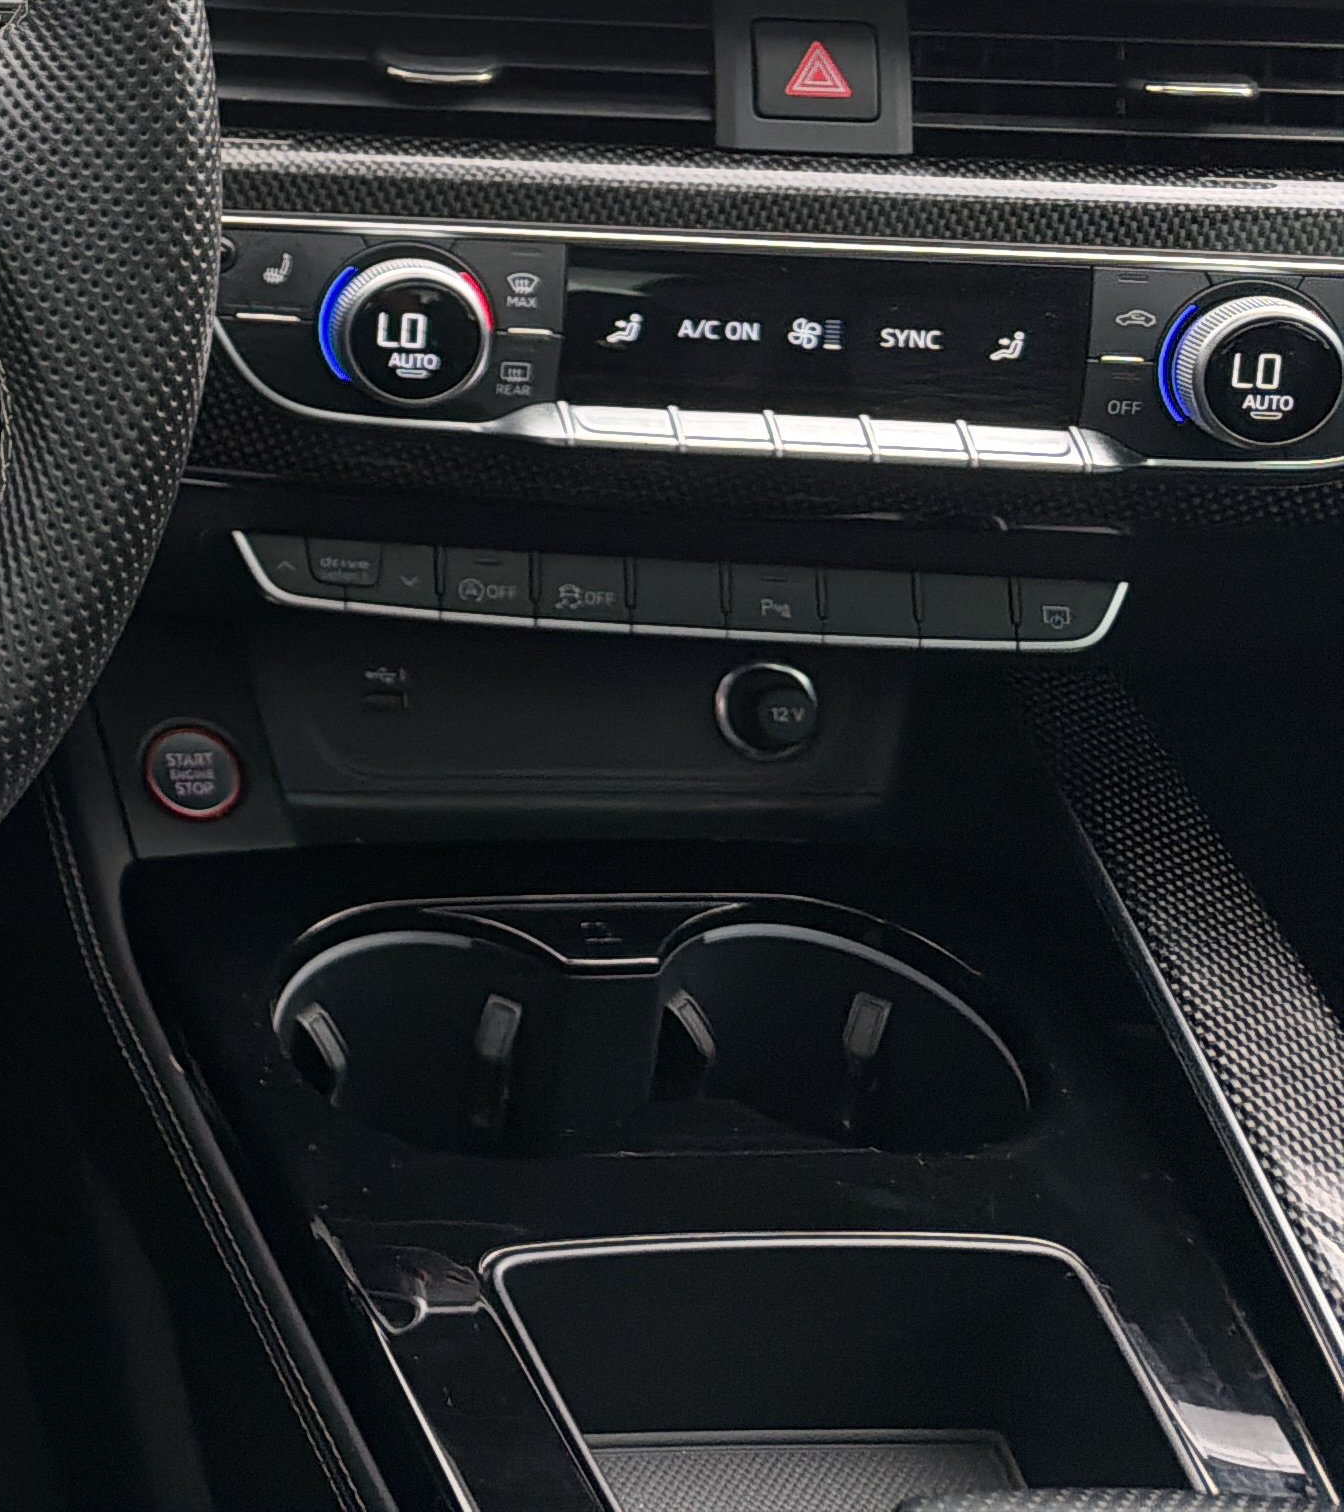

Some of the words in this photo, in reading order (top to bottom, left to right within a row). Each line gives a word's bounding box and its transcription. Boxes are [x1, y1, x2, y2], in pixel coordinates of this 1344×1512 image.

[506, 295, 537, 309] MAX
[376, 311, 428, 349] LO
[677, 319, 721, 340] A/C
[725, 321, 761, 341] ON
[880, 327, 943, 350] SYNC
[388, 352, 442, 371] AUTO
[1231, 352, 1282, 390] LO
[496, 382, 531, 397] REAR
[1107, 399, 1143, 416] OFF
[1242, 394, 1295, 412] AUTO
[486, 584, 517, 601] OFF
[584, 591, 615, 607] OFF
[770, 706, 789, 723] 12
[791, 707, 806, 723] V
[165, 752, 213, 768] START
[174, 781, 215, 797] STOP
